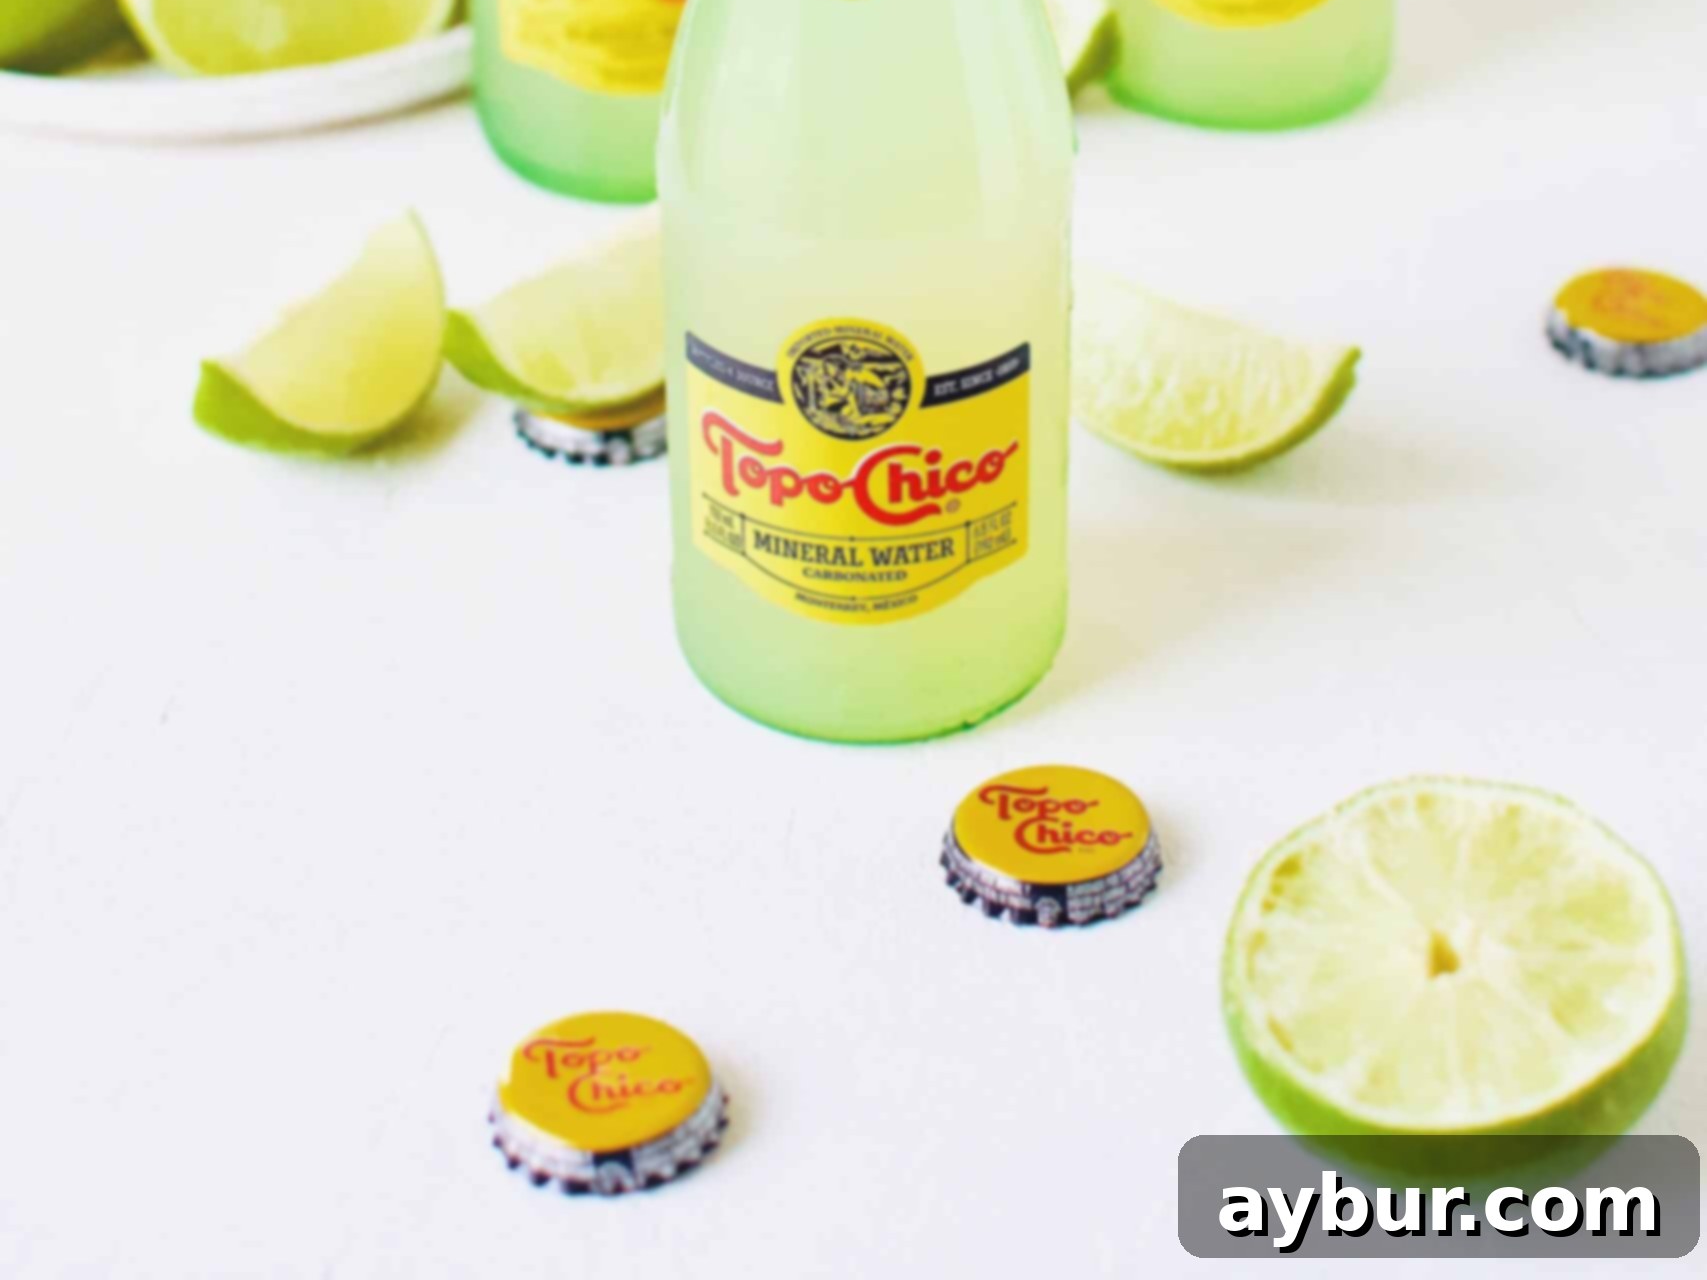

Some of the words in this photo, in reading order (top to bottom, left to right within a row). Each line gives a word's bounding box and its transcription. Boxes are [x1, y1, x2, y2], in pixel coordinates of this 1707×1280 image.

[701, 410, 848, 507] Topo
[851, 444, 1019, 527] Chico
[753, 528, 864, 567] MINERAL
[868, 536, 955, 567] WATER
[802, 567, 908, 583] CARBONATED
[978, 783, 1100, 821] Topo
[1012, 816, 1133, 855] Chico
[522, 1035, 653, 1080] Topo
[567, 1071, 695, 1115] Chico
